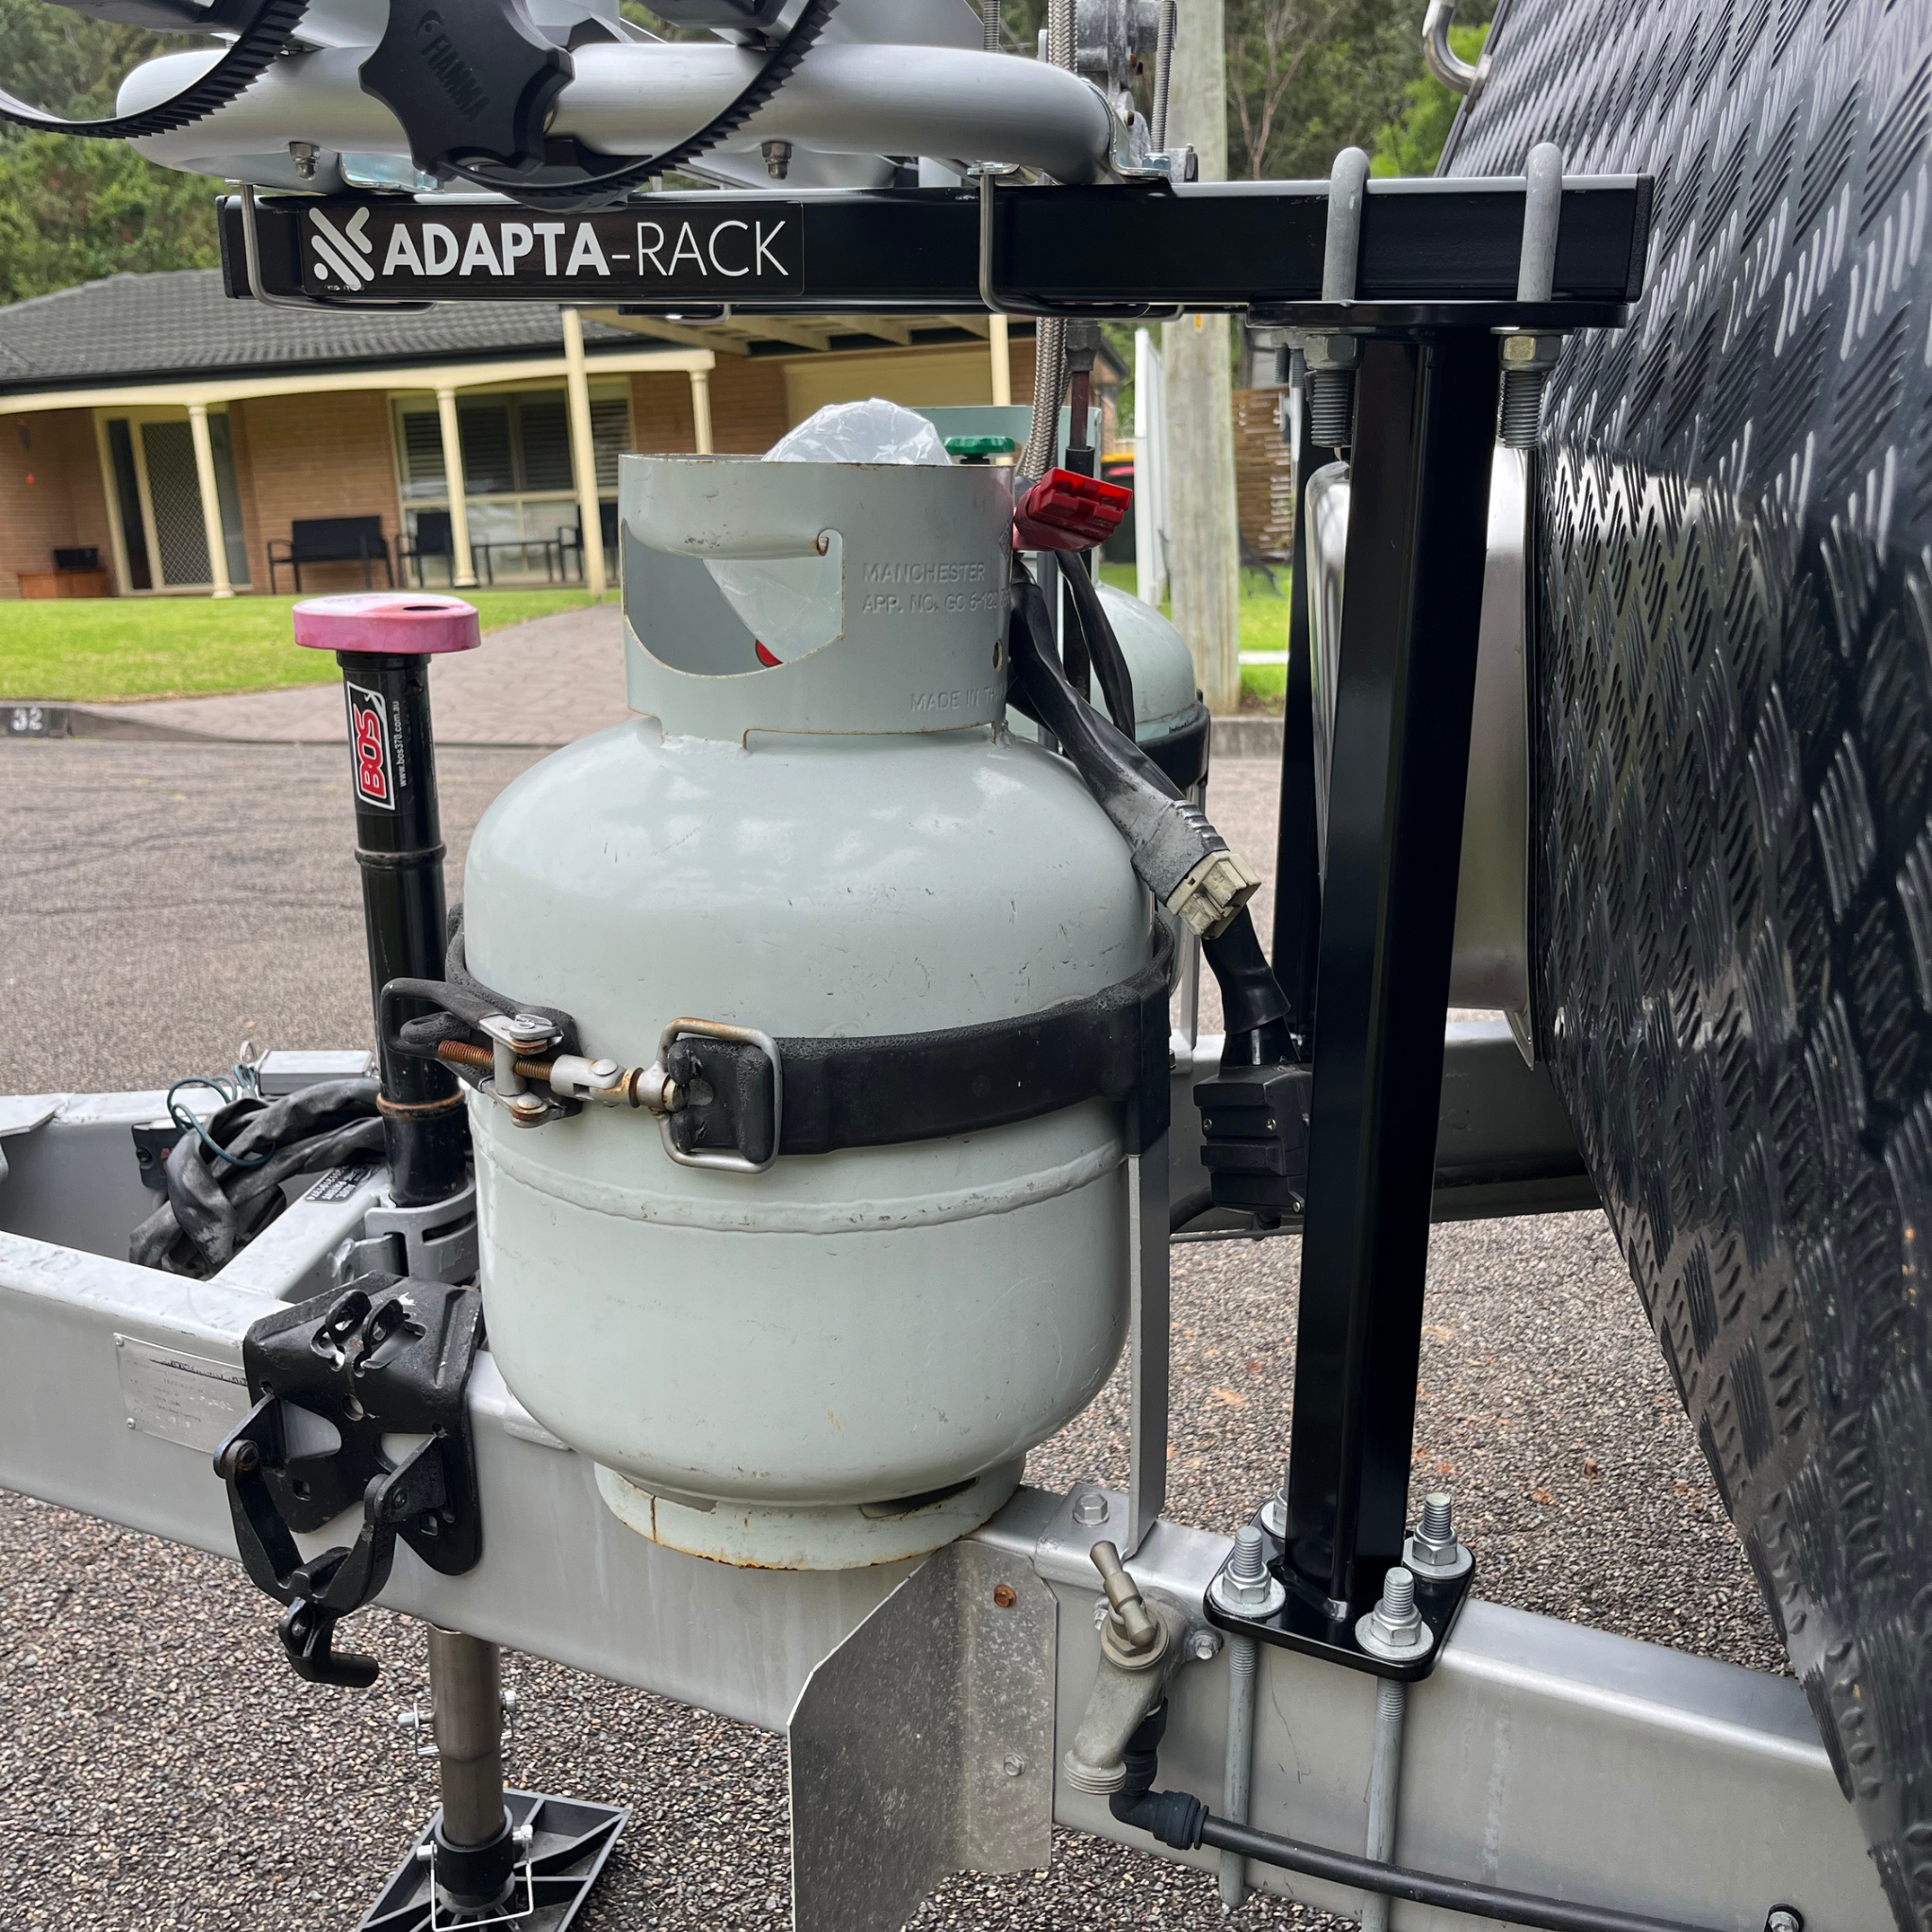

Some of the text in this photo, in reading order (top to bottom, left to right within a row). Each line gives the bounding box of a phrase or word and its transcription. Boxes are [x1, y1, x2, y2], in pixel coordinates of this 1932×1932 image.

[421, 34, 491, 123] FIAMMA
[381, 220, 790, 277] ADAPTA-RACK
[862, 561, 986, 584] MANCHESTER
[862, 593, 905, 614] APP.
[12, 707, 43, 731] 32
[910, 690, 961, 712] MADE
[966, 688, 980, 708] IN
[353, 703, 387, 799] BOS
[391, 700, 408, 789] www.bos370.com.au
